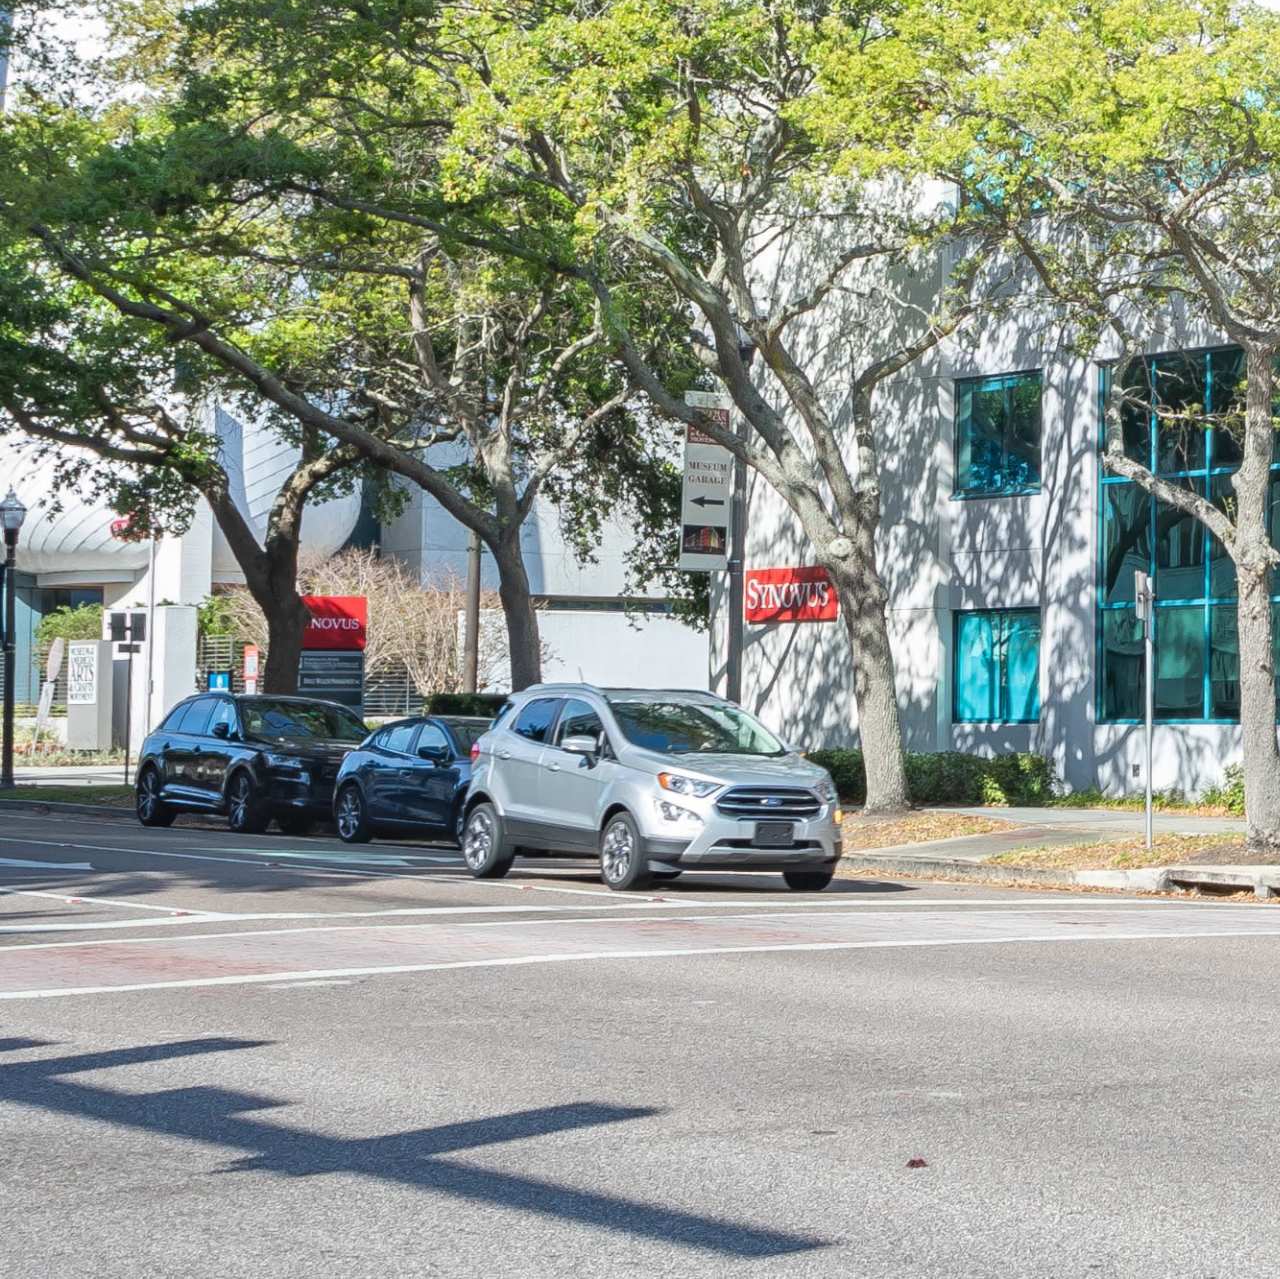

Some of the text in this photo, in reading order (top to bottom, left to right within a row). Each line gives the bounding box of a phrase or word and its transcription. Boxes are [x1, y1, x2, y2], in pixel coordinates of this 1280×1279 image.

[688, 460, 728, 472] MUSEUM
[747, 578, 829, 610] SYNOVUS
[311, 618, 360, 630] NOVUS
